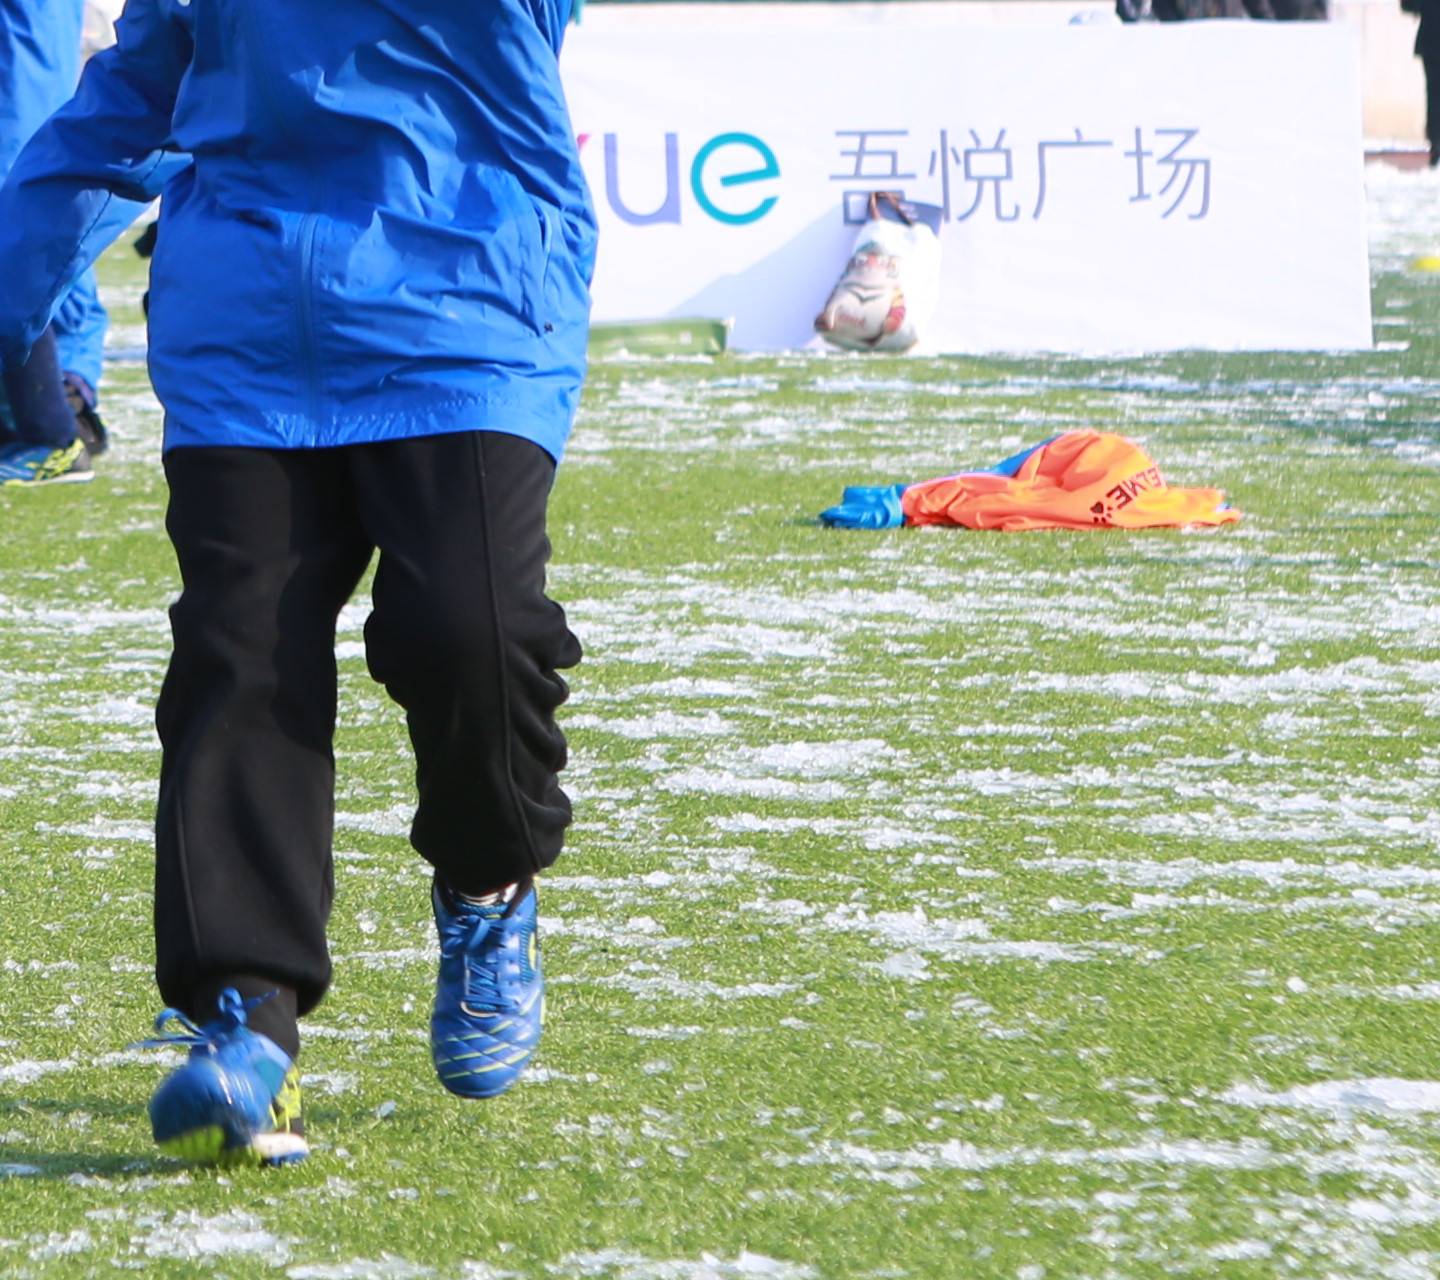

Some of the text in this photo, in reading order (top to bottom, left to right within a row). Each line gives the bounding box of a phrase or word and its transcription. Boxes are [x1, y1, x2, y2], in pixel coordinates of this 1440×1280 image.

[577, 126, 1212, 226] ue 吾悦广场
